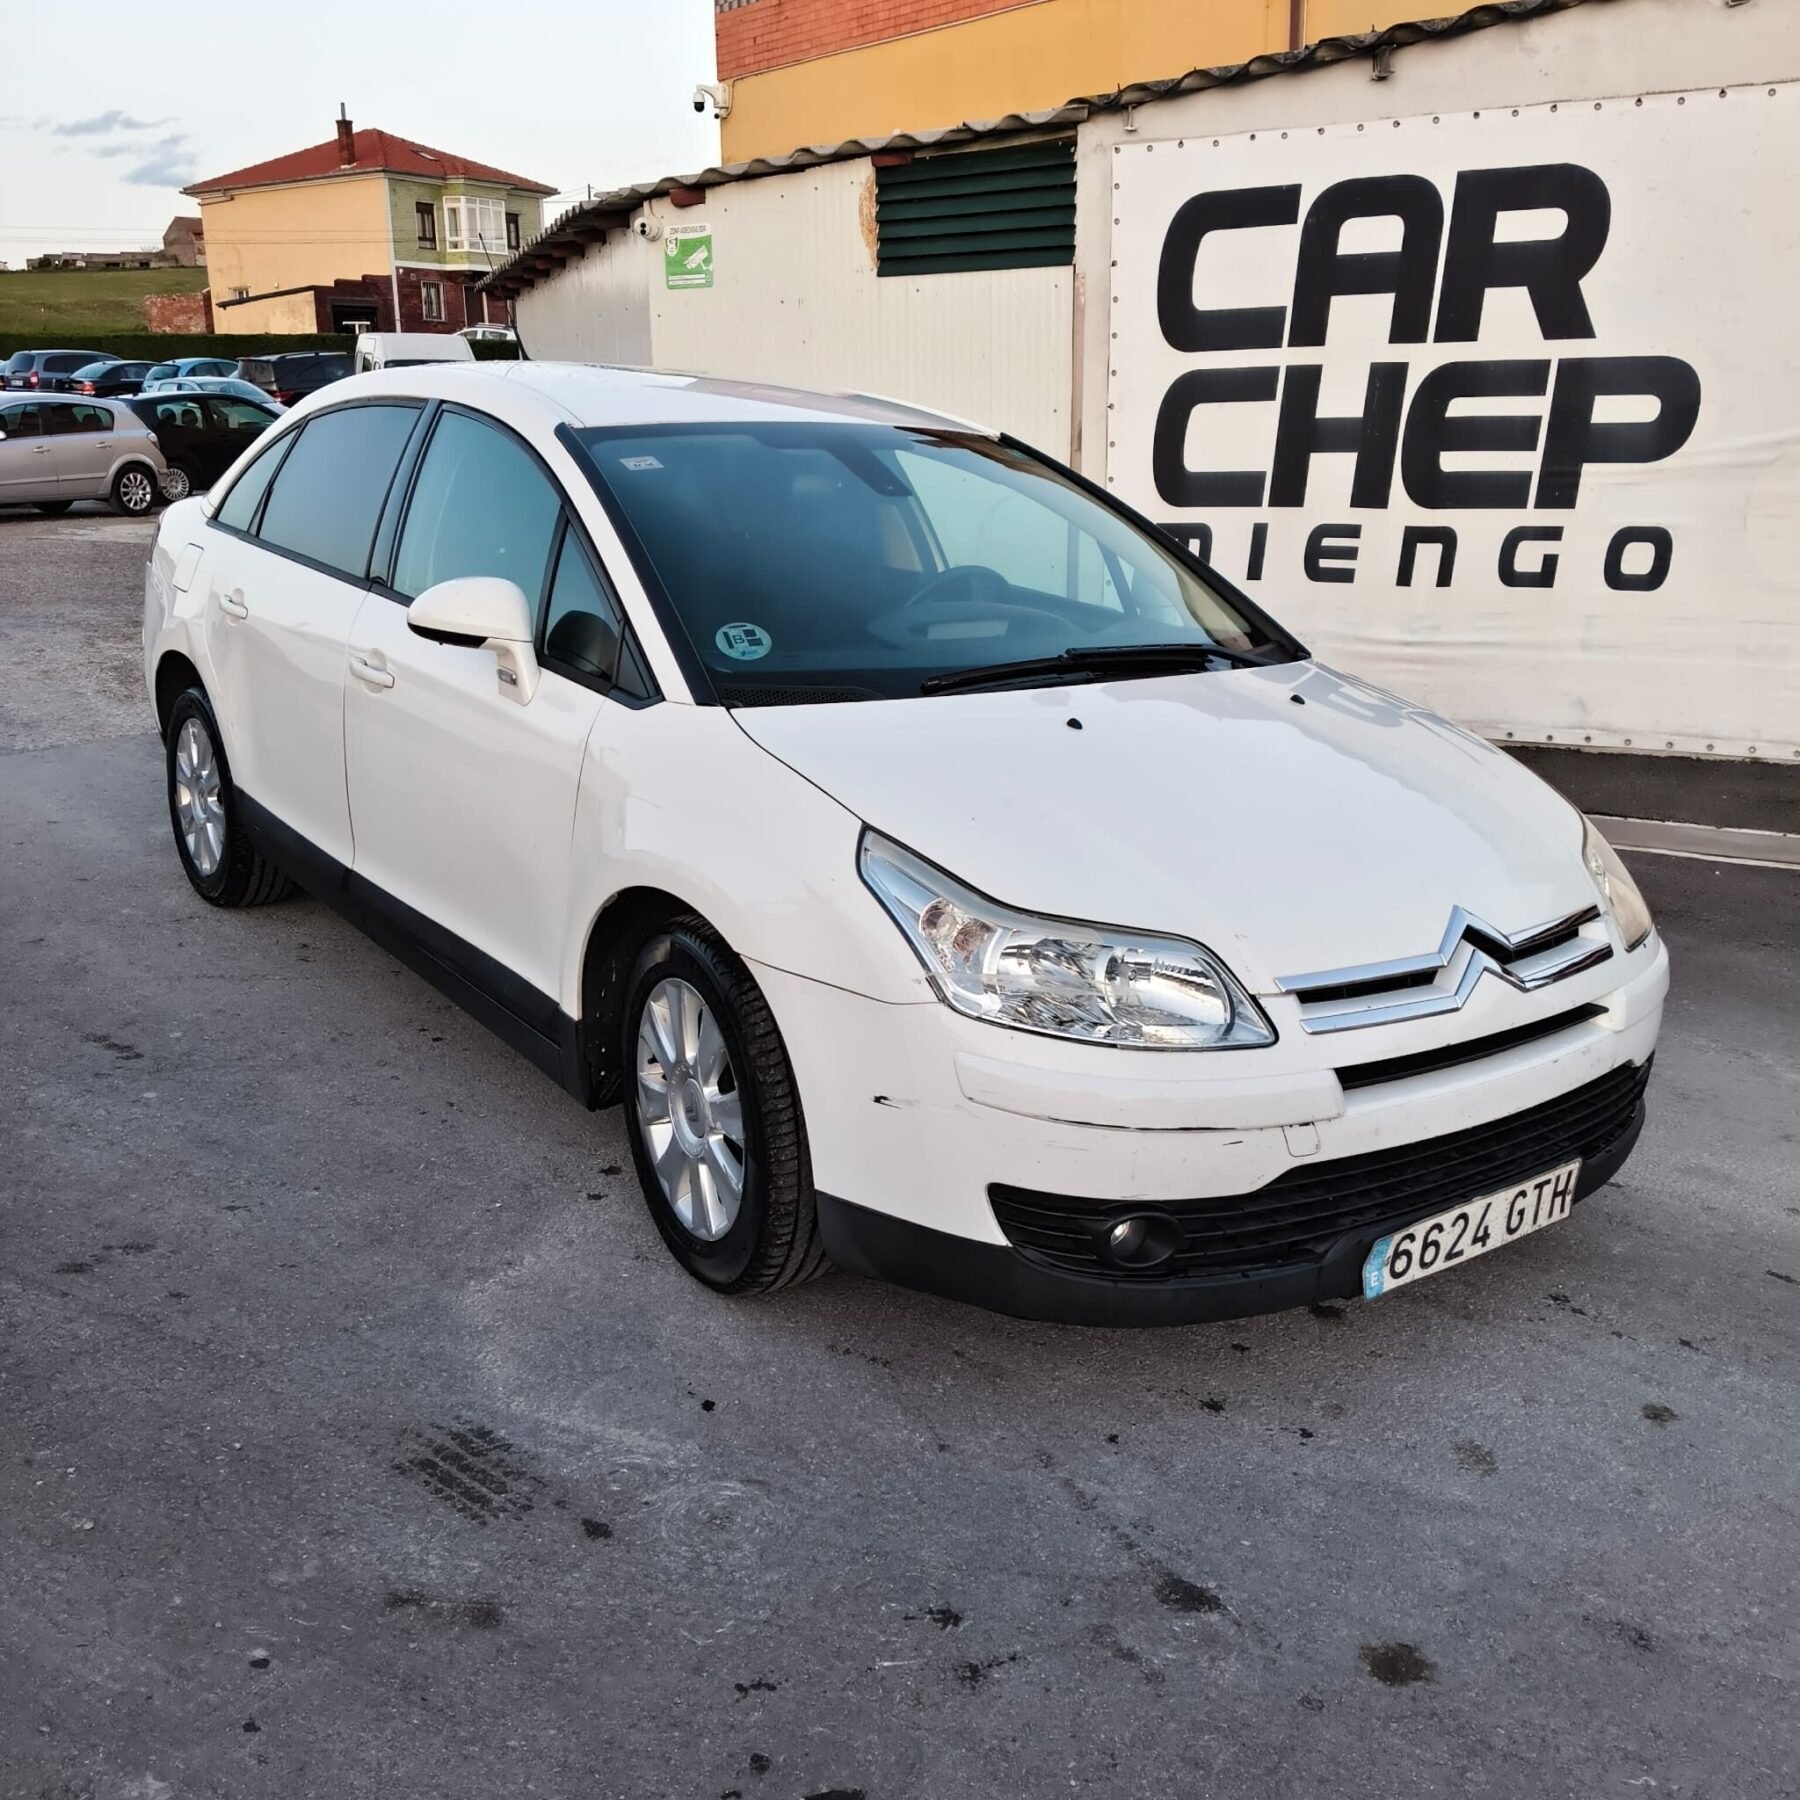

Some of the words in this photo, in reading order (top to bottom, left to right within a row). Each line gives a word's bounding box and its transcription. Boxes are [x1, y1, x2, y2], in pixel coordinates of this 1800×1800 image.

[1157, 163, 1611, 353] CAR
[1153, 356, 1701, 510] CHEP
[1389, 1202, 1492, 1280] 6624
[1505, 1169, 1573, 1236] GTH
